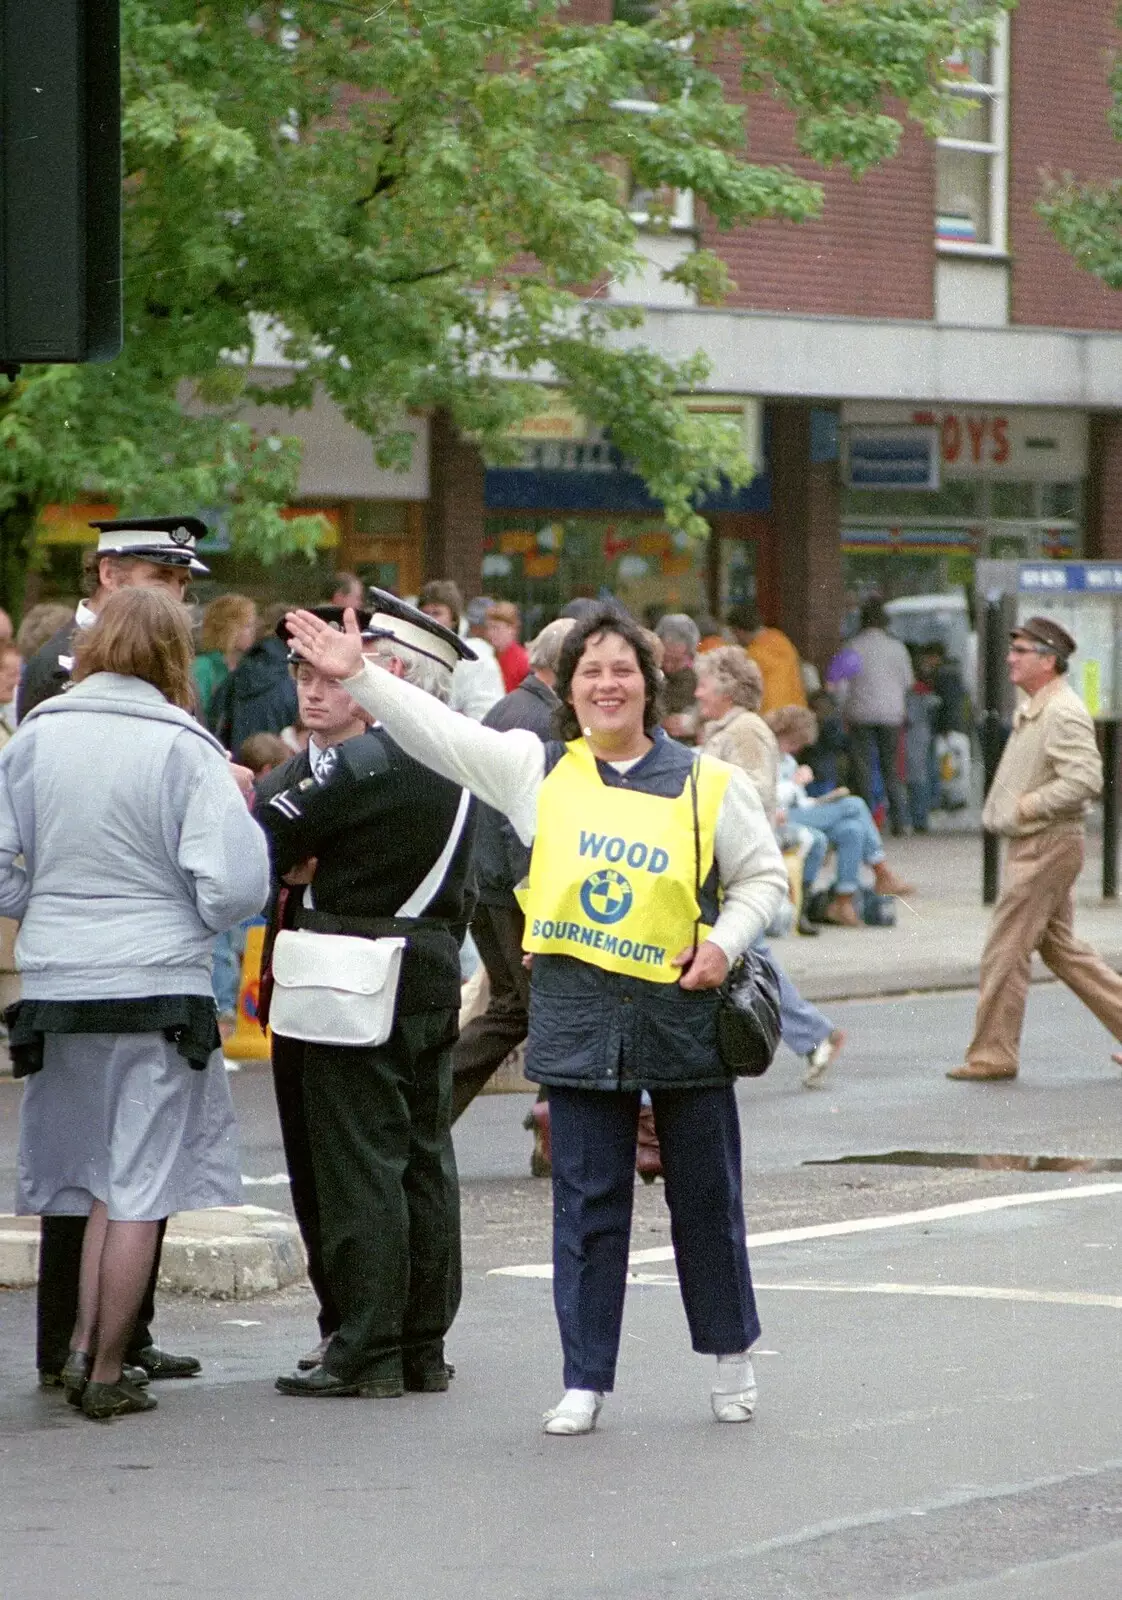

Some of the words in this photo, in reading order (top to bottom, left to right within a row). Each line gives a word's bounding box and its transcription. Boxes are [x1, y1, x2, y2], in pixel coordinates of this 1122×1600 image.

[579, 831, 669, 874] WOOD
[588, 870, 631, 894] BMW
[532, 919, 665, 966] BOURNEMOUTH
